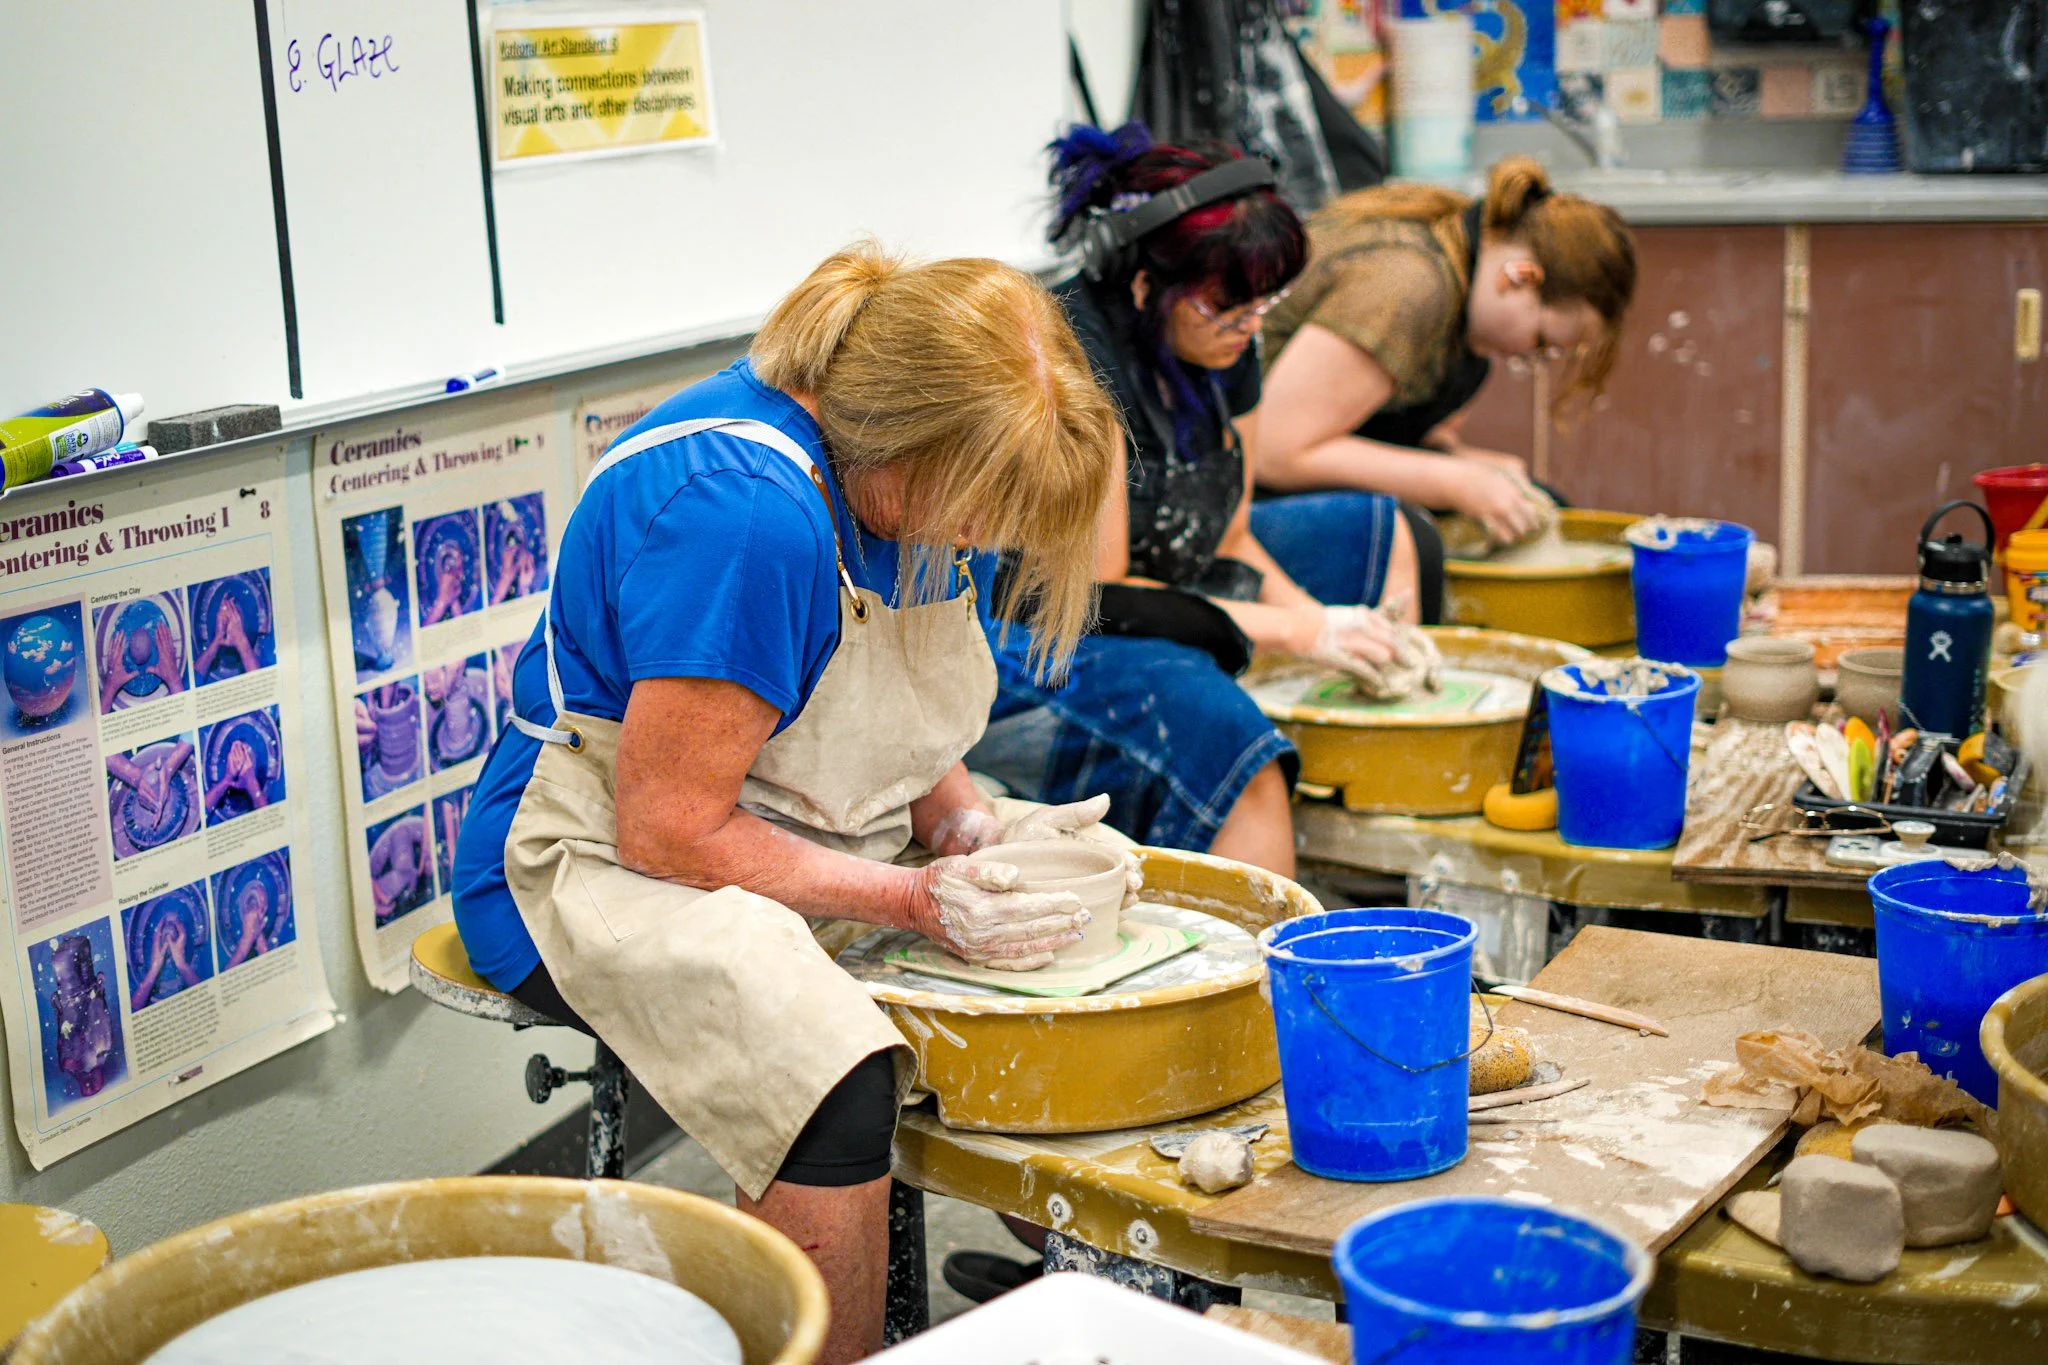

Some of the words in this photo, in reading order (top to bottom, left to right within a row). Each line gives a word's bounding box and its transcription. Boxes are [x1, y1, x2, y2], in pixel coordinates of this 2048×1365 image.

[503, 74, 553, 99] Making
[557, 68, 637, 92] connections
[641, 65, 692, 86] between
[502, 103, 539, 127] visual
[544, 102, 566, 123] arts
[571, 98, 593, 119] and
[598, 97, 628, 116] other
[330, 427, 422, 466] Ceramics
[330, 463, 410, 494] Centering
[414, 454, 428, 477] &
[433, 442, 503, 473] Throwing
[259, 501, 271, 520] 8
[95, 531, 115, 556] &
[119, 512, 217, 551] Throwing
[221, 506, 230, 528] I
[91, 592, 118, 604] Centering
[118, 590, 128, 598] the
[129, 587, 141, 595] Clay
[2, 742, 26, 755] General
[26, 733, 61, 747] Instructions
